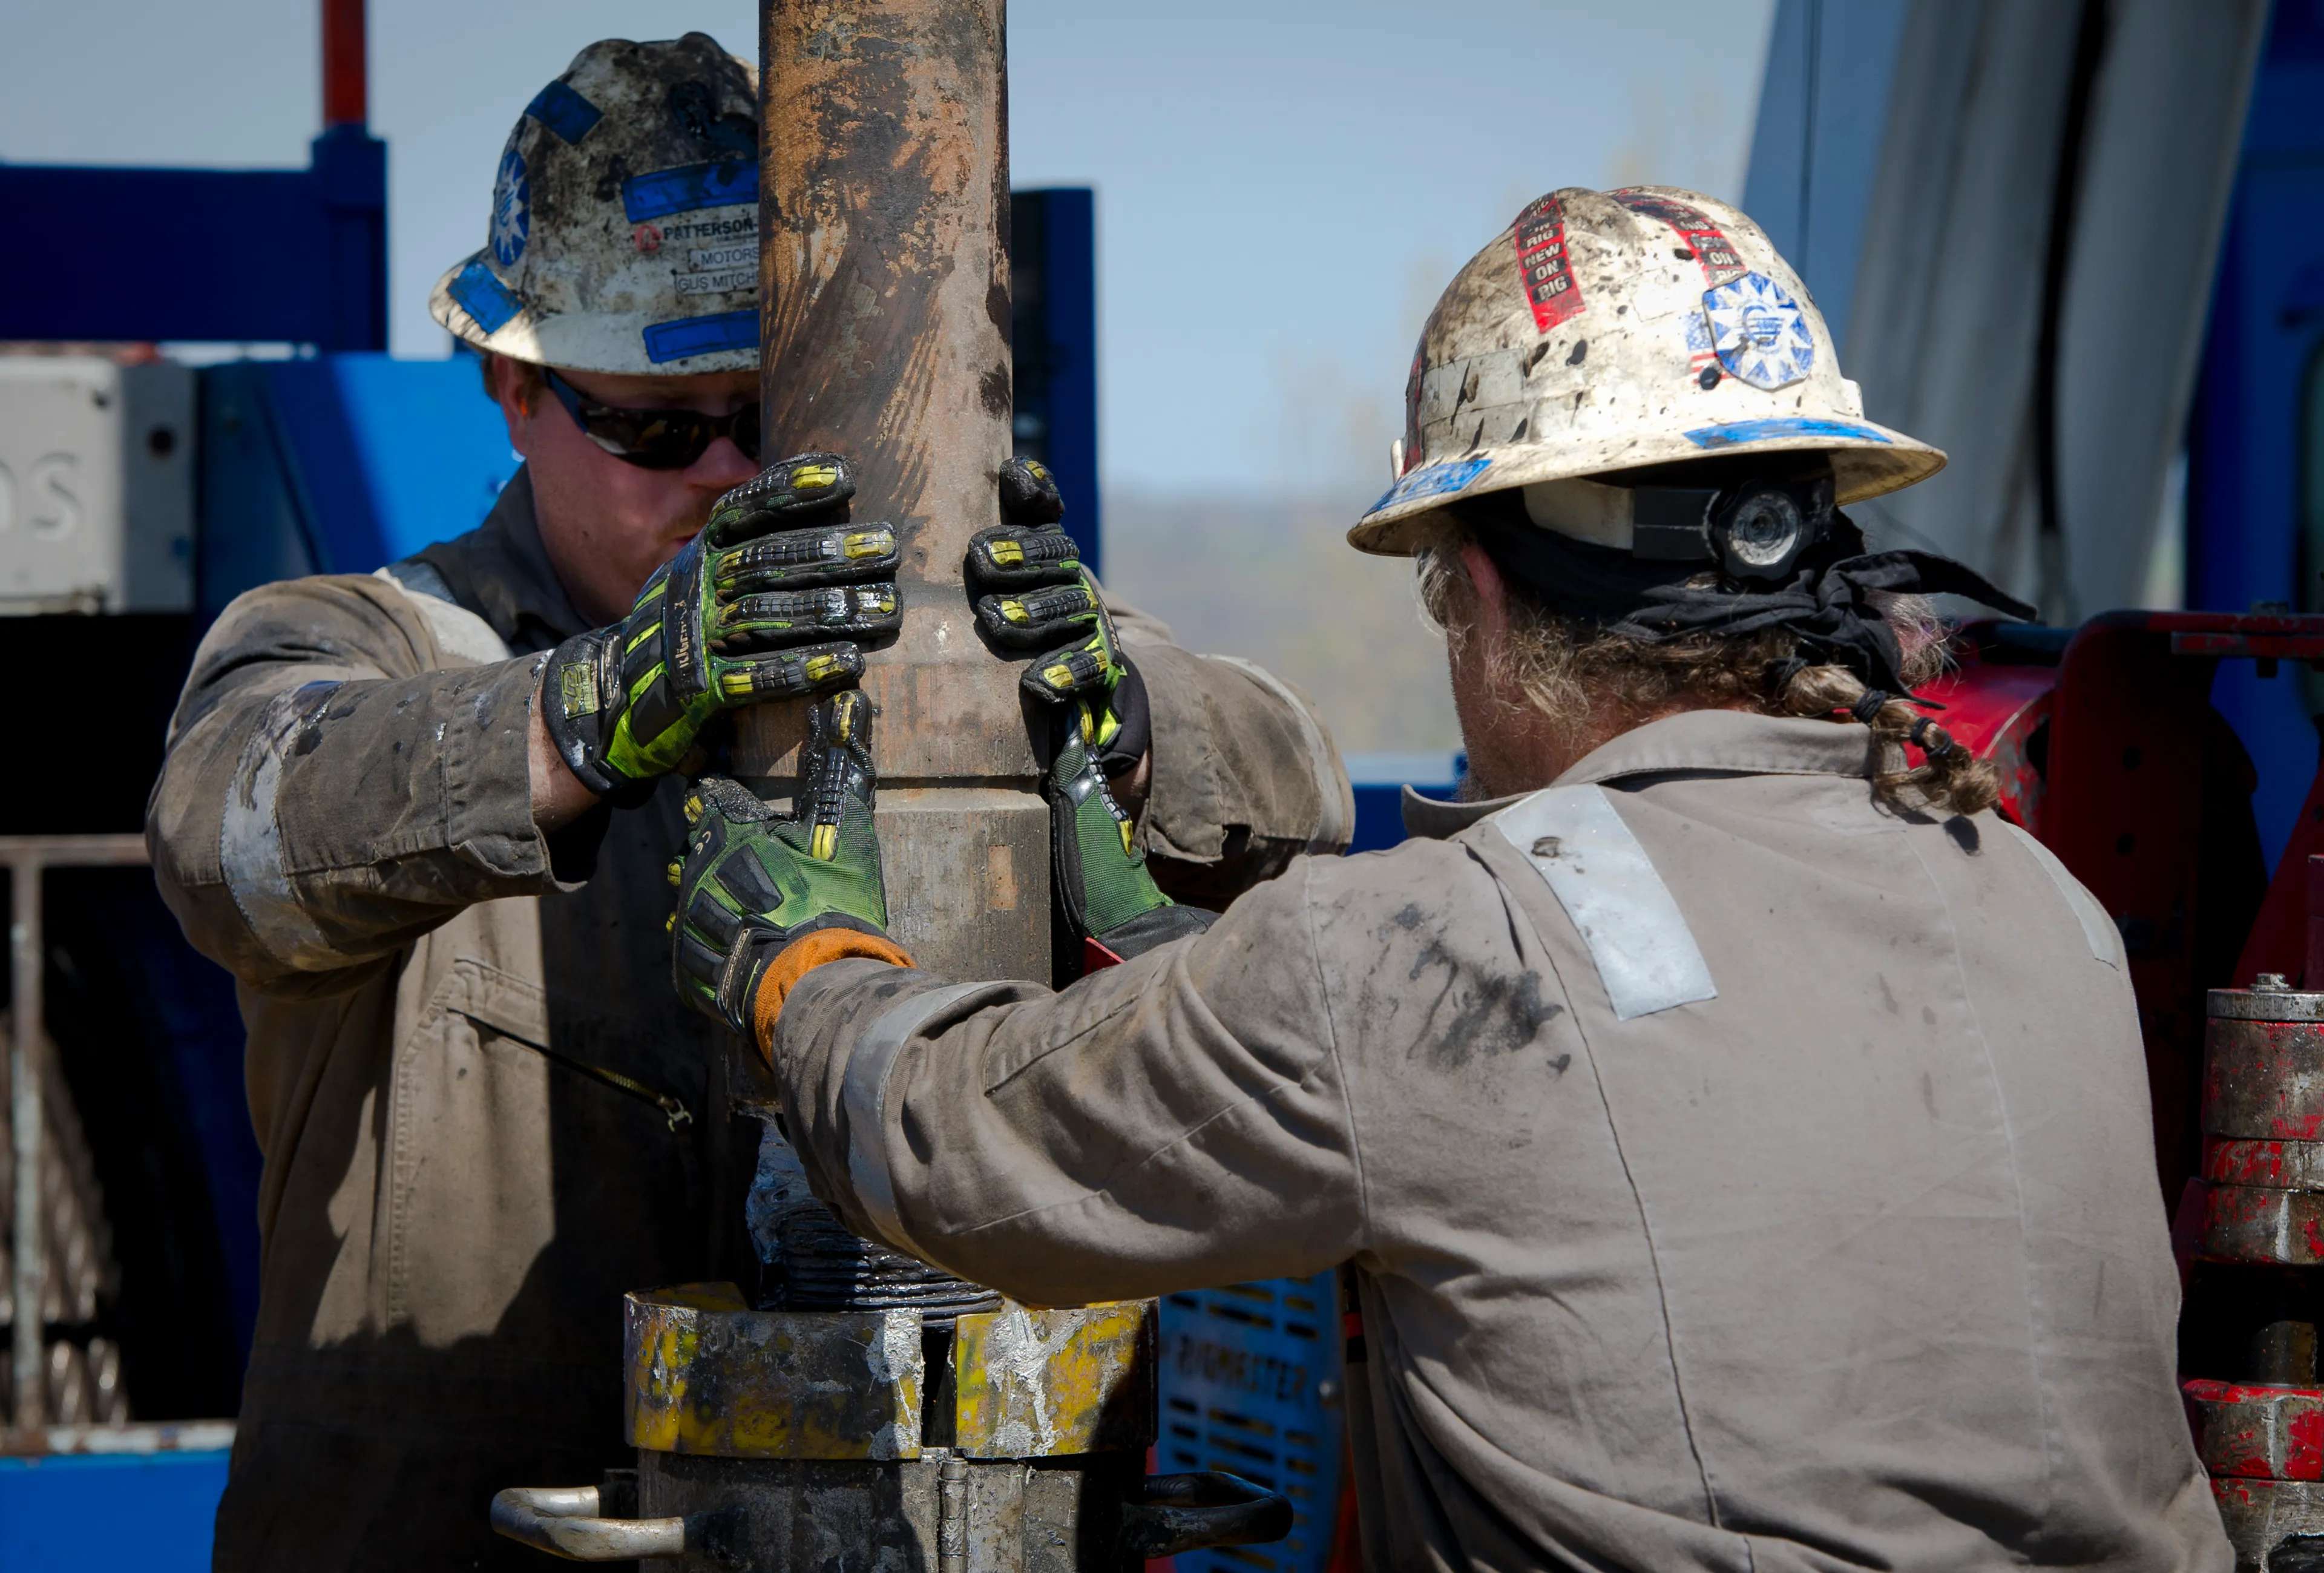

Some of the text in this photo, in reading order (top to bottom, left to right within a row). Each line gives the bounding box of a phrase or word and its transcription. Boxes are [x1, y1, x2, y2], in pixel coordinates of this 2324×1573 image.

[1524, 242, 1560, 269] NEW
[1709, 252, 1735, 266] ON
[1535, 260, 1560, 281] ON
[678, 272, 759, 292] GUS MITCH
